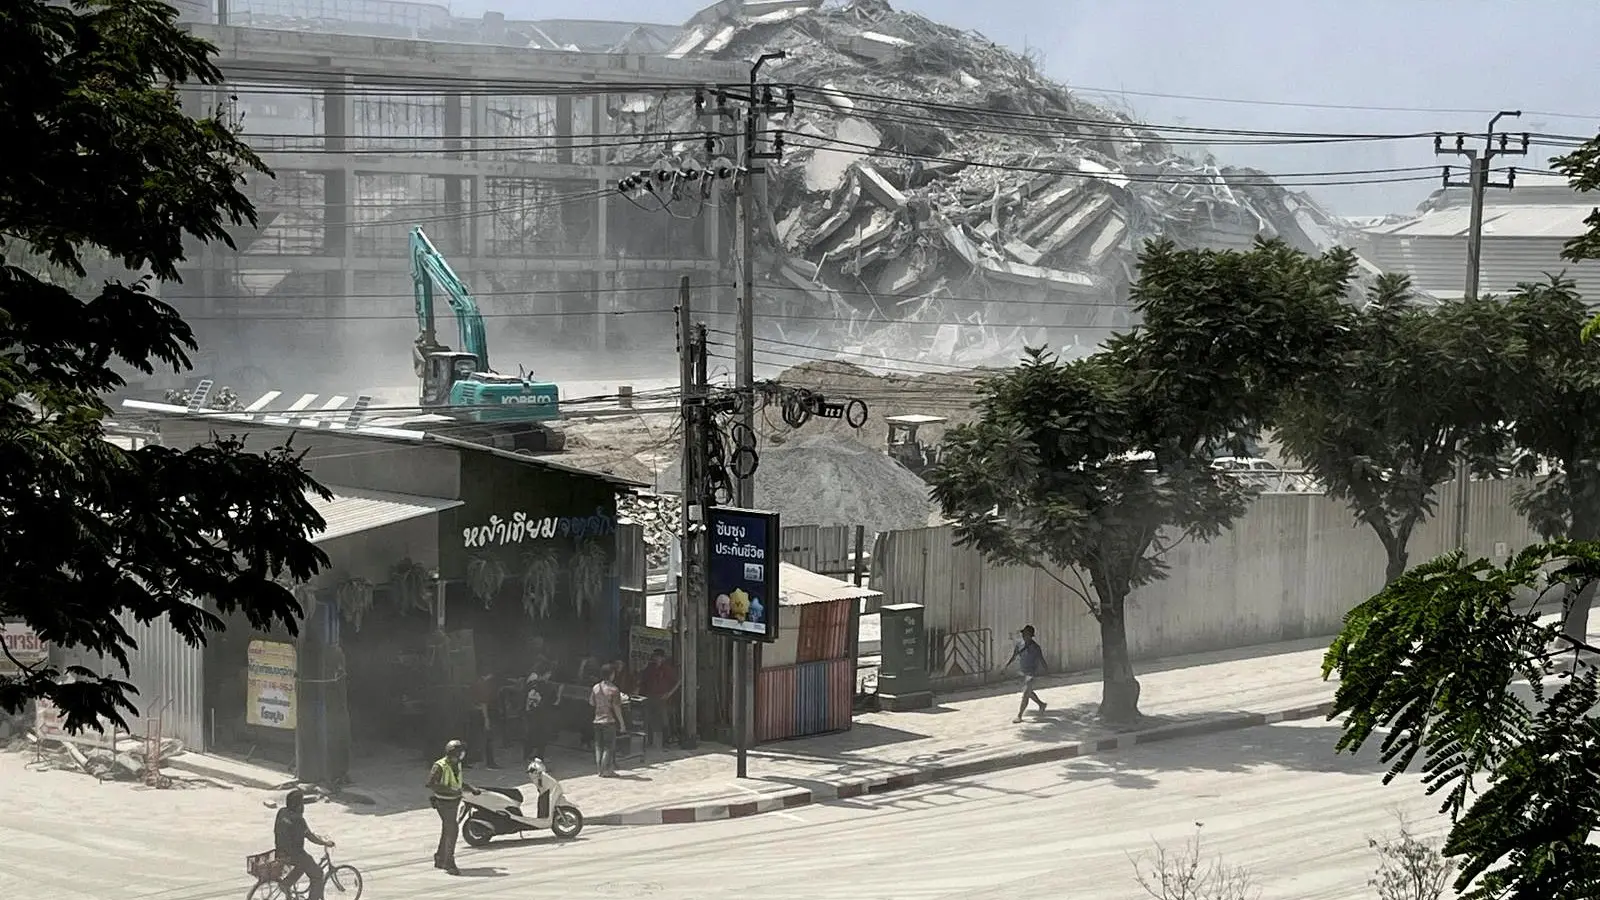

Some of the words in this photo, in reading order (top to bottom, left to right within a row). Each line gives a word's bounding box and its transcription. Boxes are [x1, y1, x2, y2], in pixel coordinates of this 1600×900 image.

[715, 542, 765, 559] ประกันชีวิต
